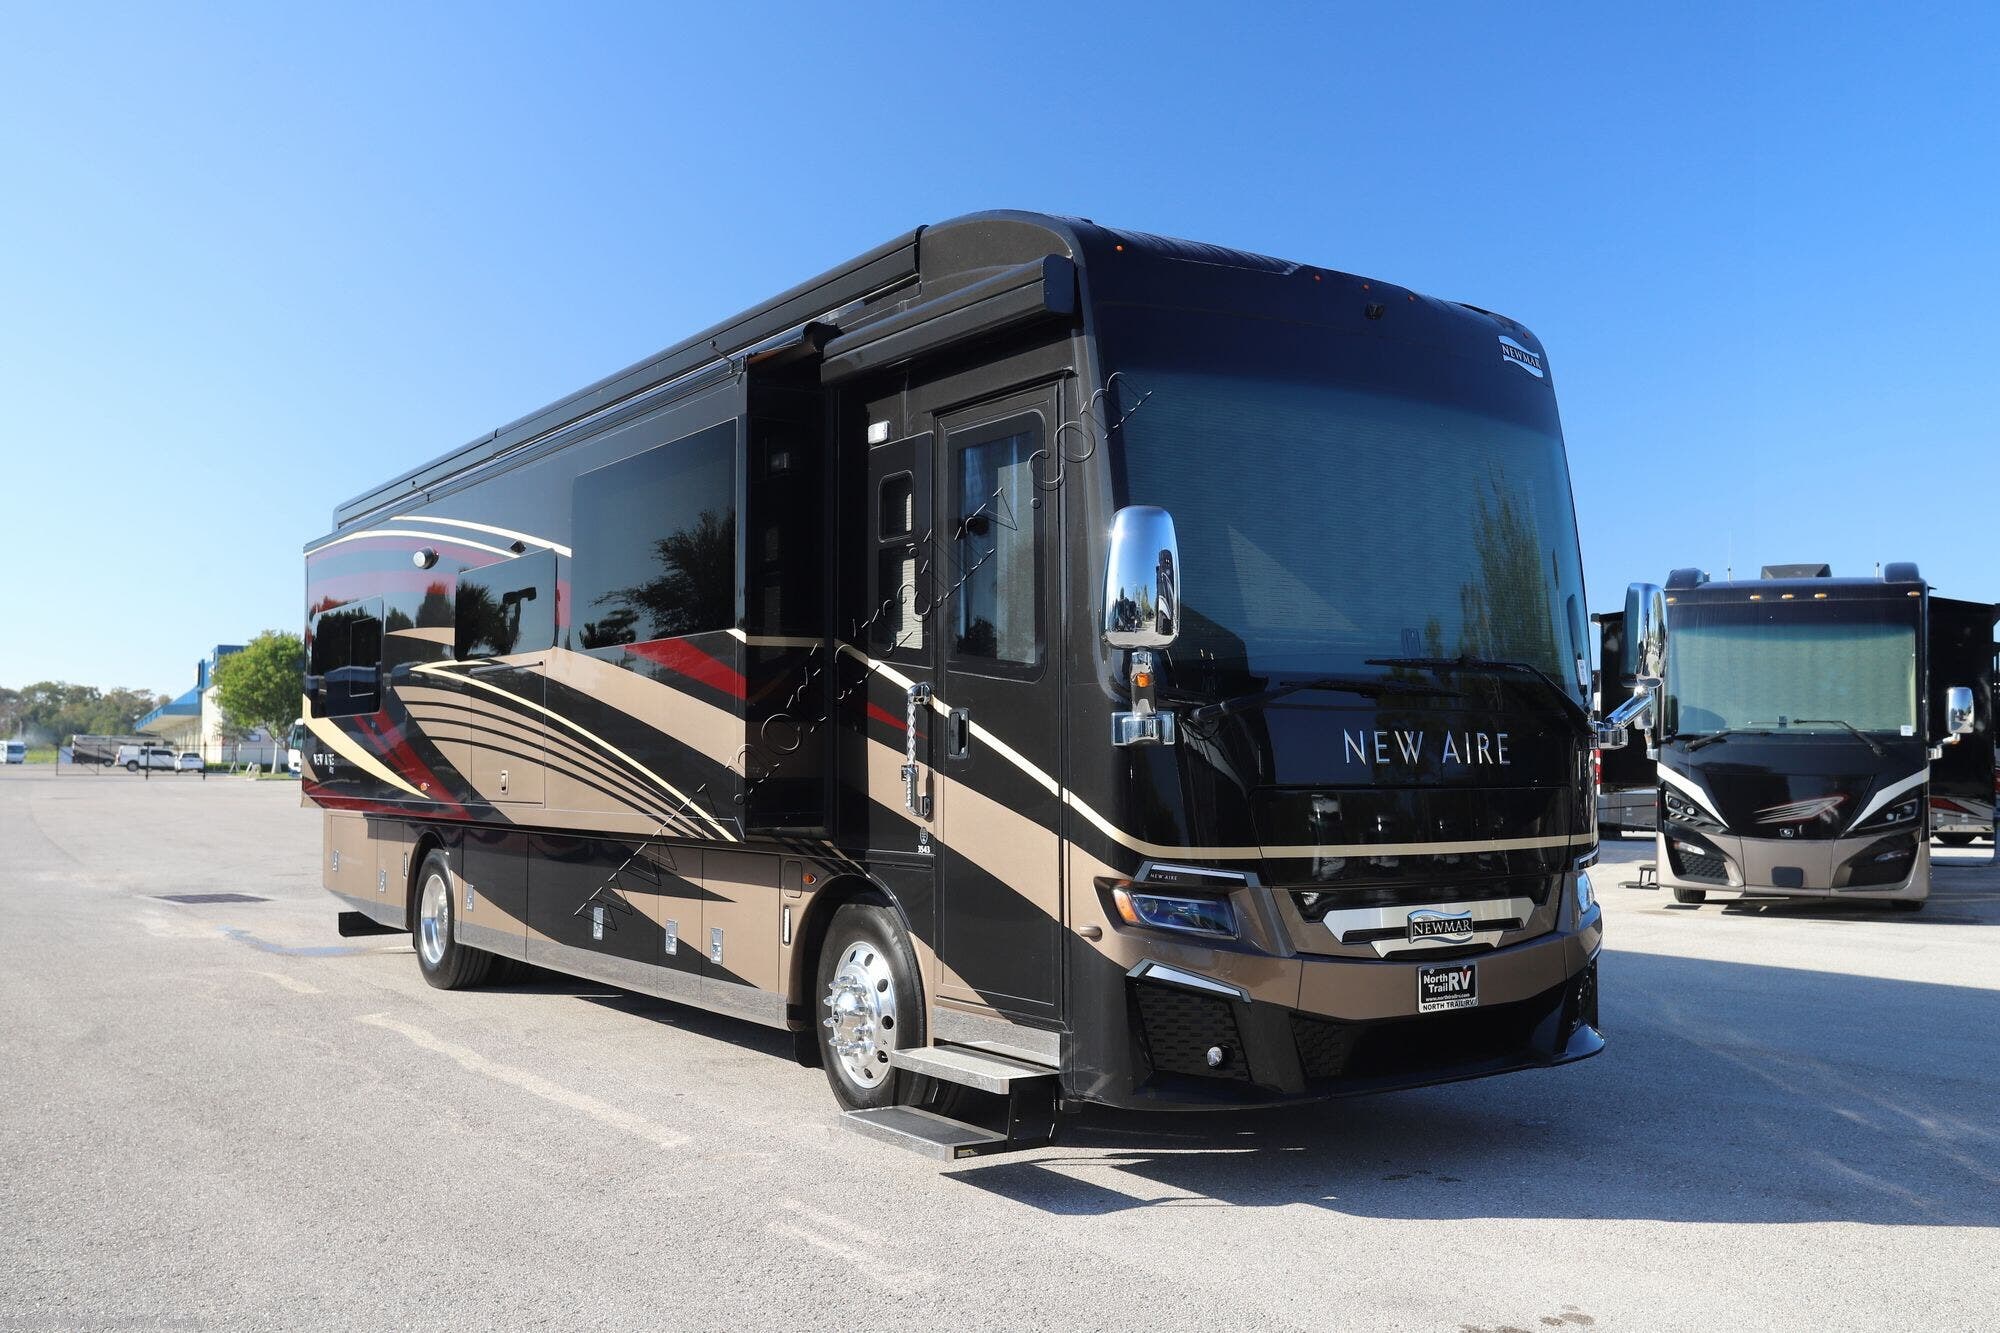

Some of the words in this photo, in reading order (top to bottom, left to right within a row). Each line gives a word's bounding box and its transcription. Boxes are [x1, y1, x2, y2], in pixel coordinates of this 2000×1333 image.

[1501, 344, 1542, 370] NEWMAR
[1343, 728, 1424, 766] NEW
[1441, 730, 1511, 765] AIRE
[917, 845, 931, 854] 3543
[1413, 919, 1471, 935] NEWMAR
[1424, 973, 1447, 984] North
[1449, 971, 1471, 991] RV
[1428, 983, 1447, 993] Trail
[1422, 1002, 1445, 1011] NORTH
